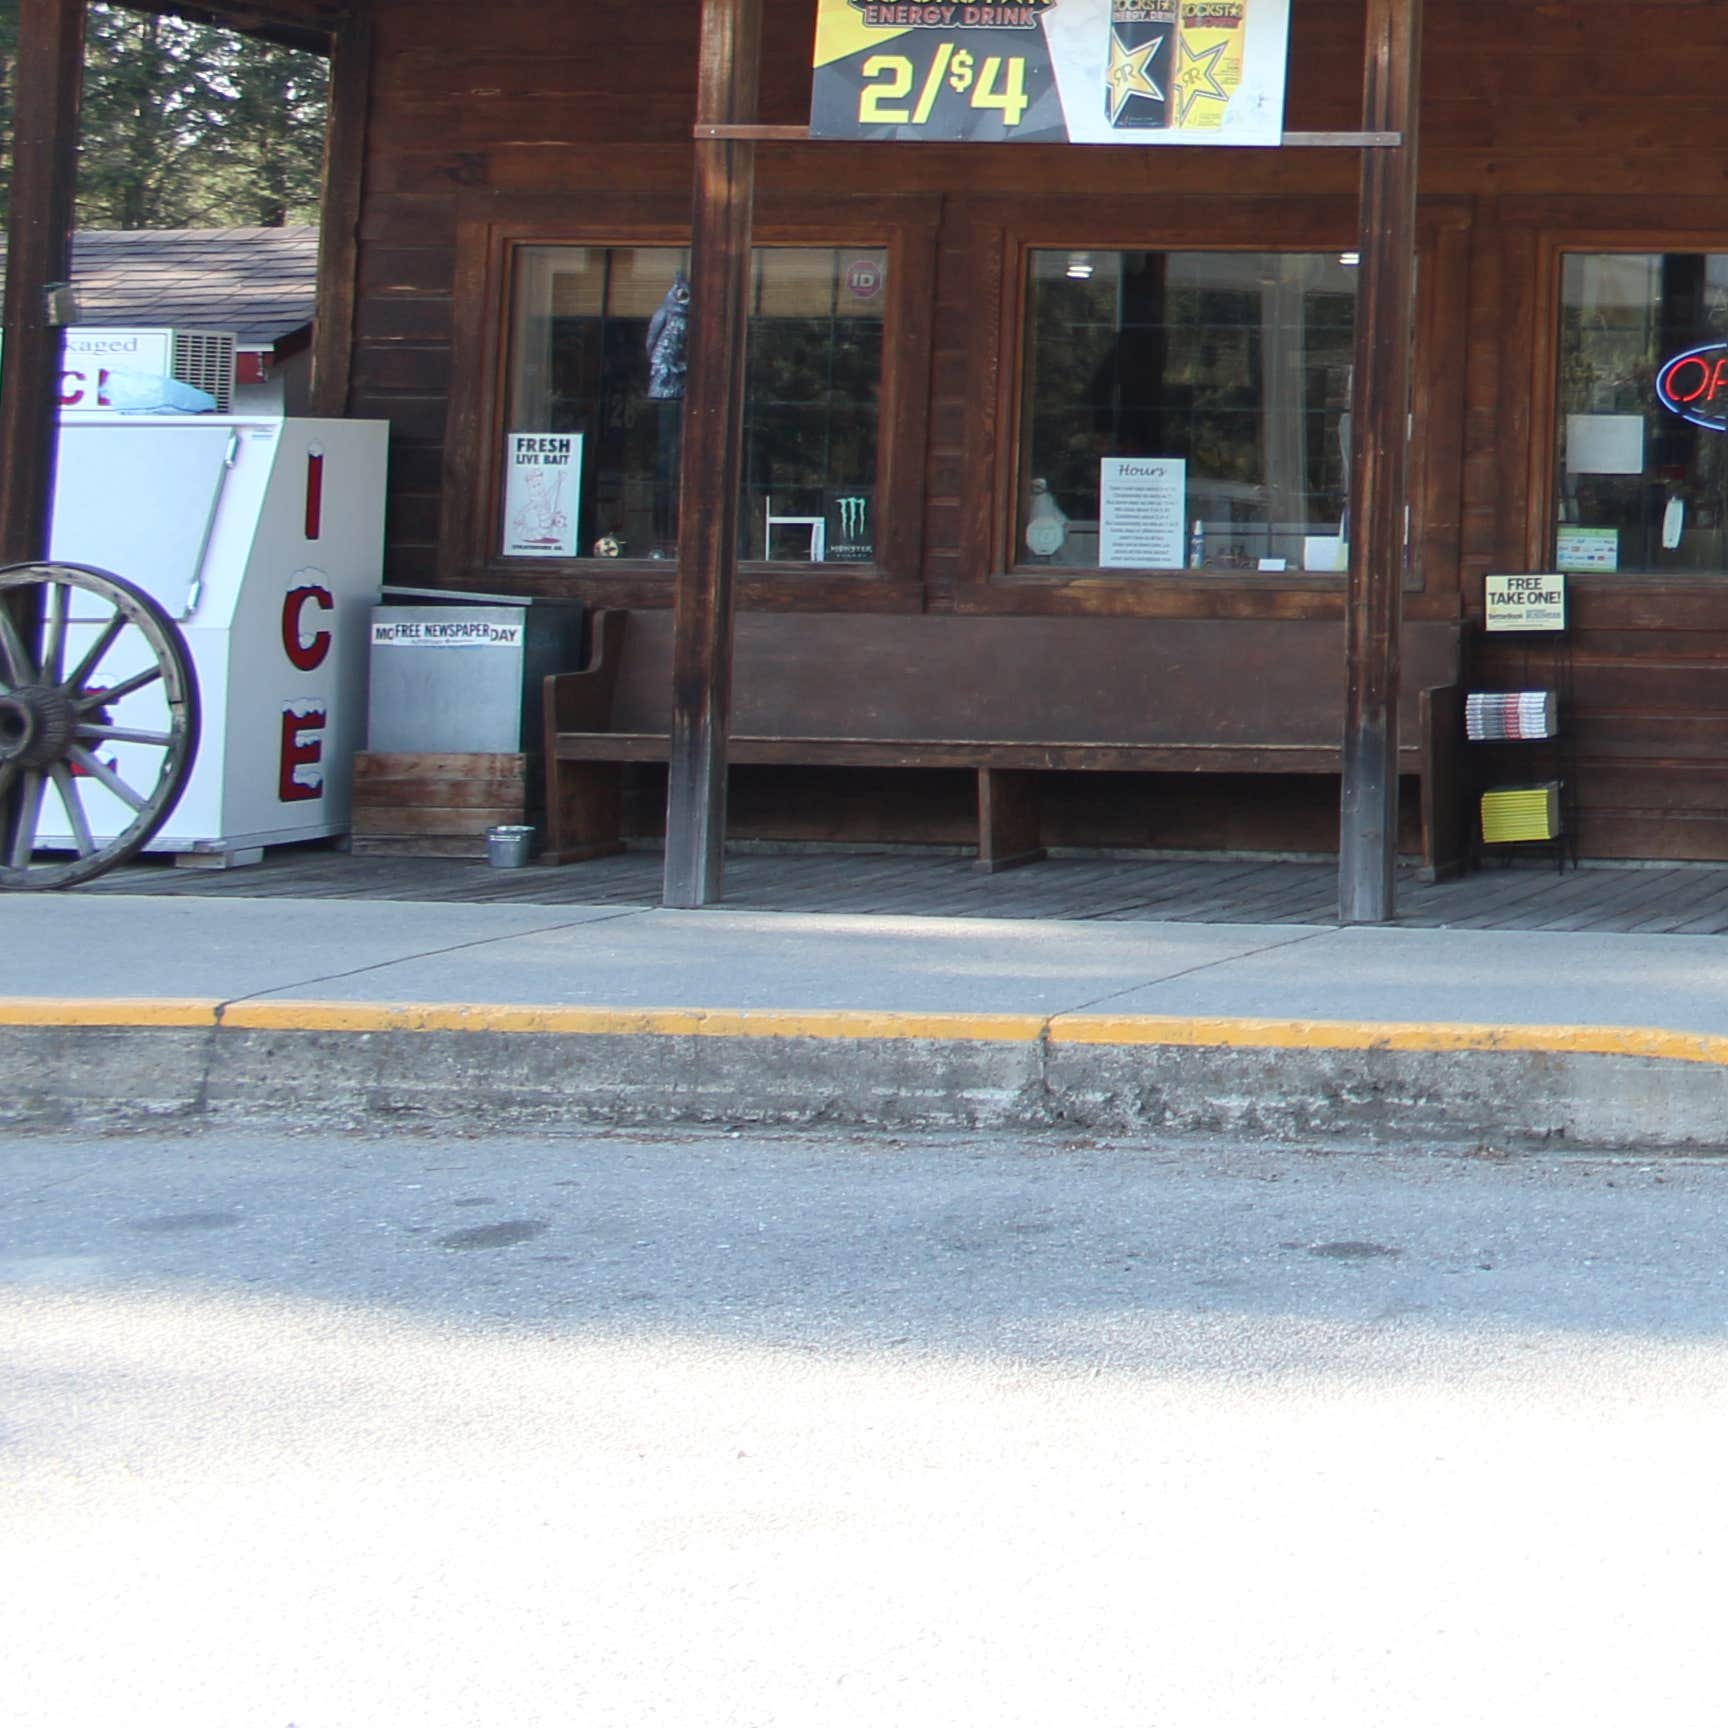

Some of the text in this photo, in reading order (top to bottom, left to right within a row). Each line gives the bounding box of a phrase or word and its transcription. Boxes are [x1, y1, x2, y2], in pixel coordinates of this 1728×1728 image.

[865, 5, 1035, 26] ENERGY DRINK
[858, 42, 1029, 126] 2/$4
[851, 274, 875, 289] ID
[516, 437, 571, 453] FRESH
[515, 453, 570, 465] LIVE BAIT
[1119, 463, 1168, 477] Hours
[1506, 577, 1543, 591] FREE
[1487, 591, 1562, 605] TAKE ONE!
[395, 623, 490, 638] FREE NEWSPAPER
